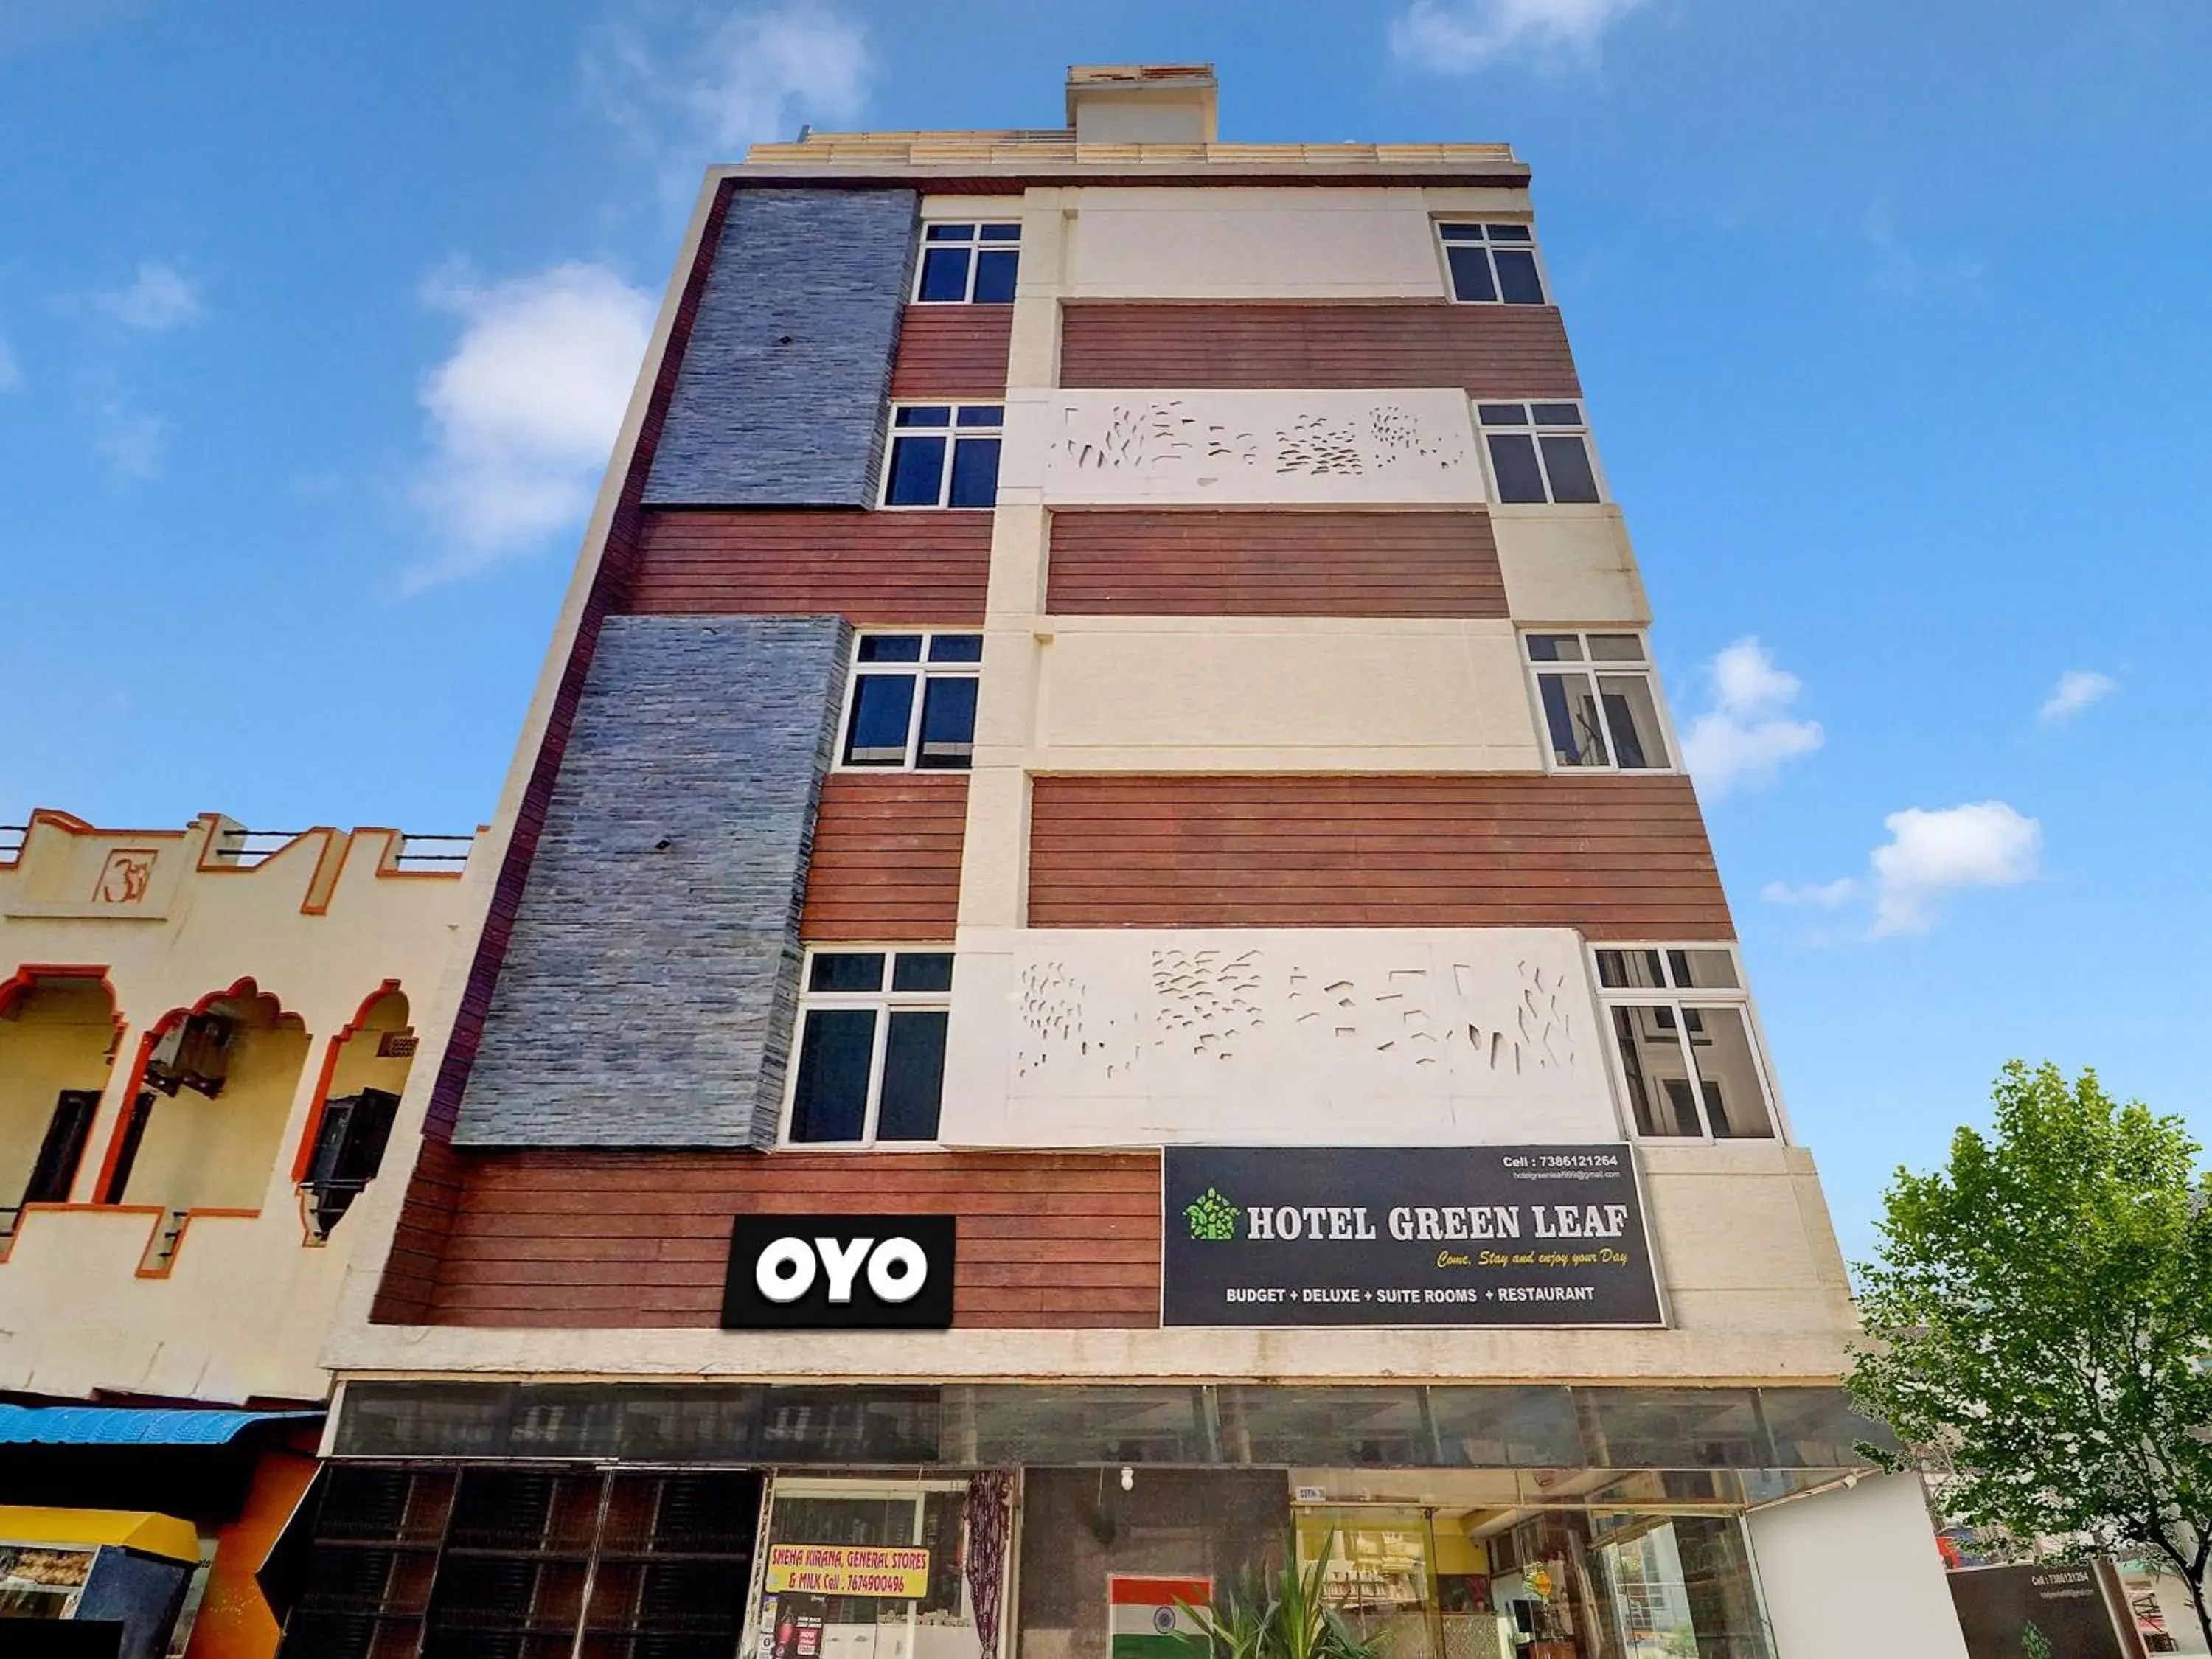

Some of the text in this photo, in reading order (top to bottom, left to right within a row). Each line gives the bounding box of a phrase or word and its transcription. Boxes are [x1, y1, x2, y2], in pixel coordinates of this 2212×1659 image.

[1503, 1155, 1528, 1167] Cell
[1539, 1155, 1618, 1166] 7386121264
[1247, 1204, 1629, 1241] HOTEL GREEN LEAF
[1478, 1250, 1510, 1267] Stay
[1512, 1251, 1535, 1263] and
[1538, 1251, 1568, 1267] enjoy
[1571, 1253, 1598, 1267] your
[1599, 1248, 1628, 1265] Day
[756, 1237, 928, 1303] OYO
[1226, 1289, 1286, 1302] BUDGET
[1303, 1289, 1360, 1302] DELUXE
[1377, 1289, 1420, 1303] SUITE
[1425, 1288, 1477, 1303] ROOMS
[1498, 1287, 1595, 1301] RESTAURANT
[772, 1548, 803, 1565] SNEHA
[847, 1551, 888, 1568] GENERAL
[892, 1552, 926, 1570] STORES
[788, 1572, 795, 1588] &
[799, 1573, 822, 1590] MILK
[824, 1575, 839, 1590] Cell
[847, 1574, 904, 1591] 7674900496
